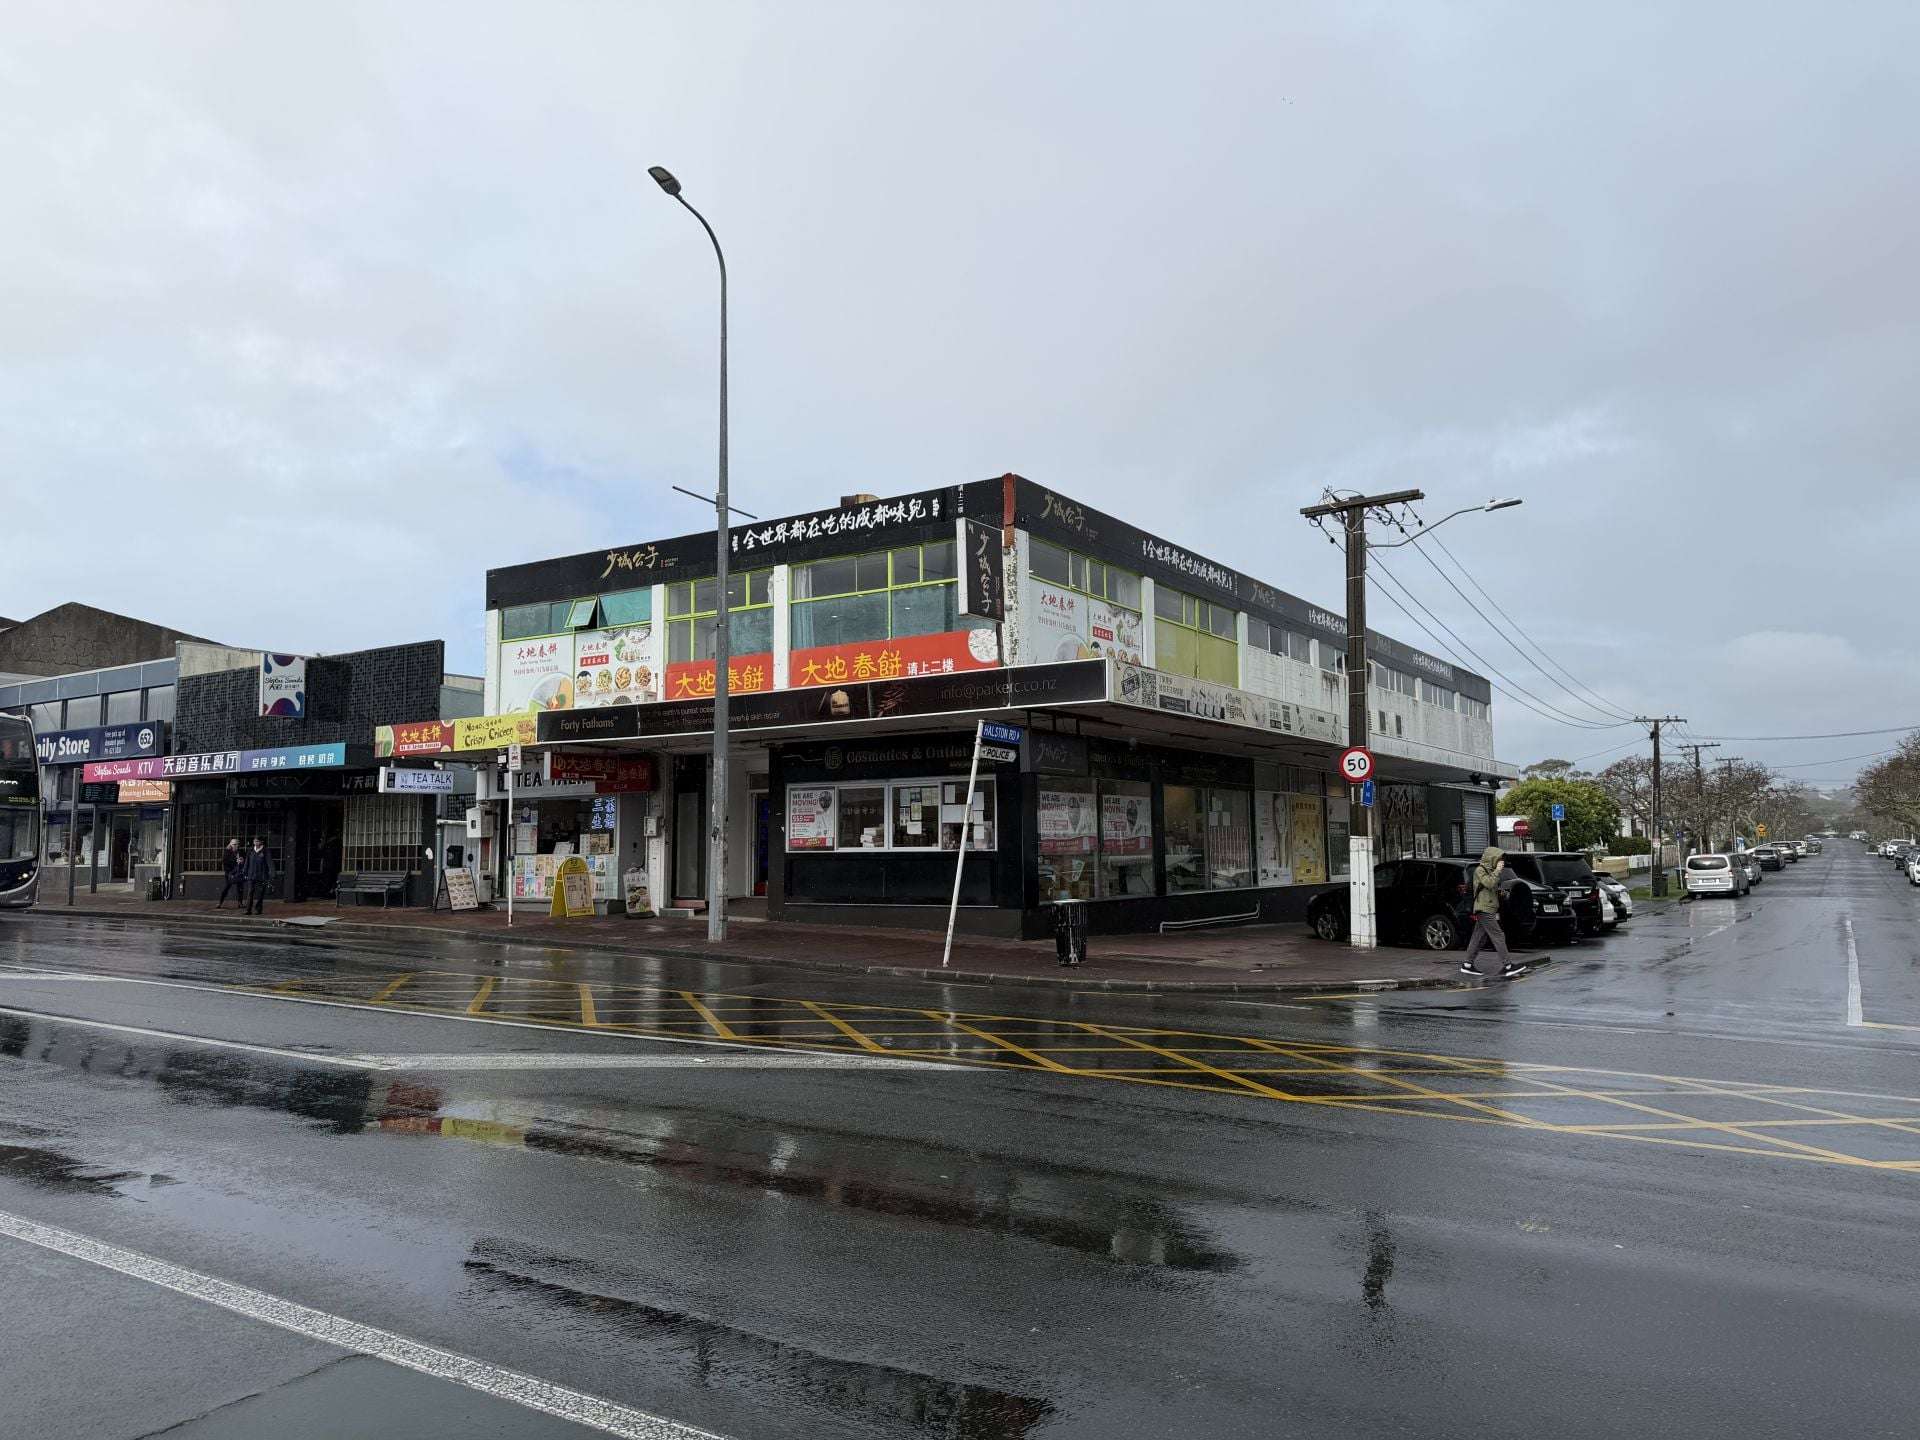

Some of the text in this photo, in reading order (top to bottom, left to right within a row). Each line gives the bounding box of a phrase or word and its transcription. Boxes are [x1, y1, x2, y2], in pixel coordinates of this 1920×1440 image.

[800, 649, 903, 686] 大地春餅
[906, 658, 955, 676] 请上二楼
[560, 719, 580, 733] Forty
[984, 724, 1009, 740] HALSTON
[140, 733, 152, 745] 652
[37, 736, 90, 761] mily Store
[987, 746, 1010, 760] POLICE
[137, 761, 153, 775] KTV
[163, 753, 237, 774] 天韵音乐餐厅
[1347, 757, 1367, 772] 50
[412, 772, 452, 784] TEA TALK
[516, 772, 543, 788] TEA
